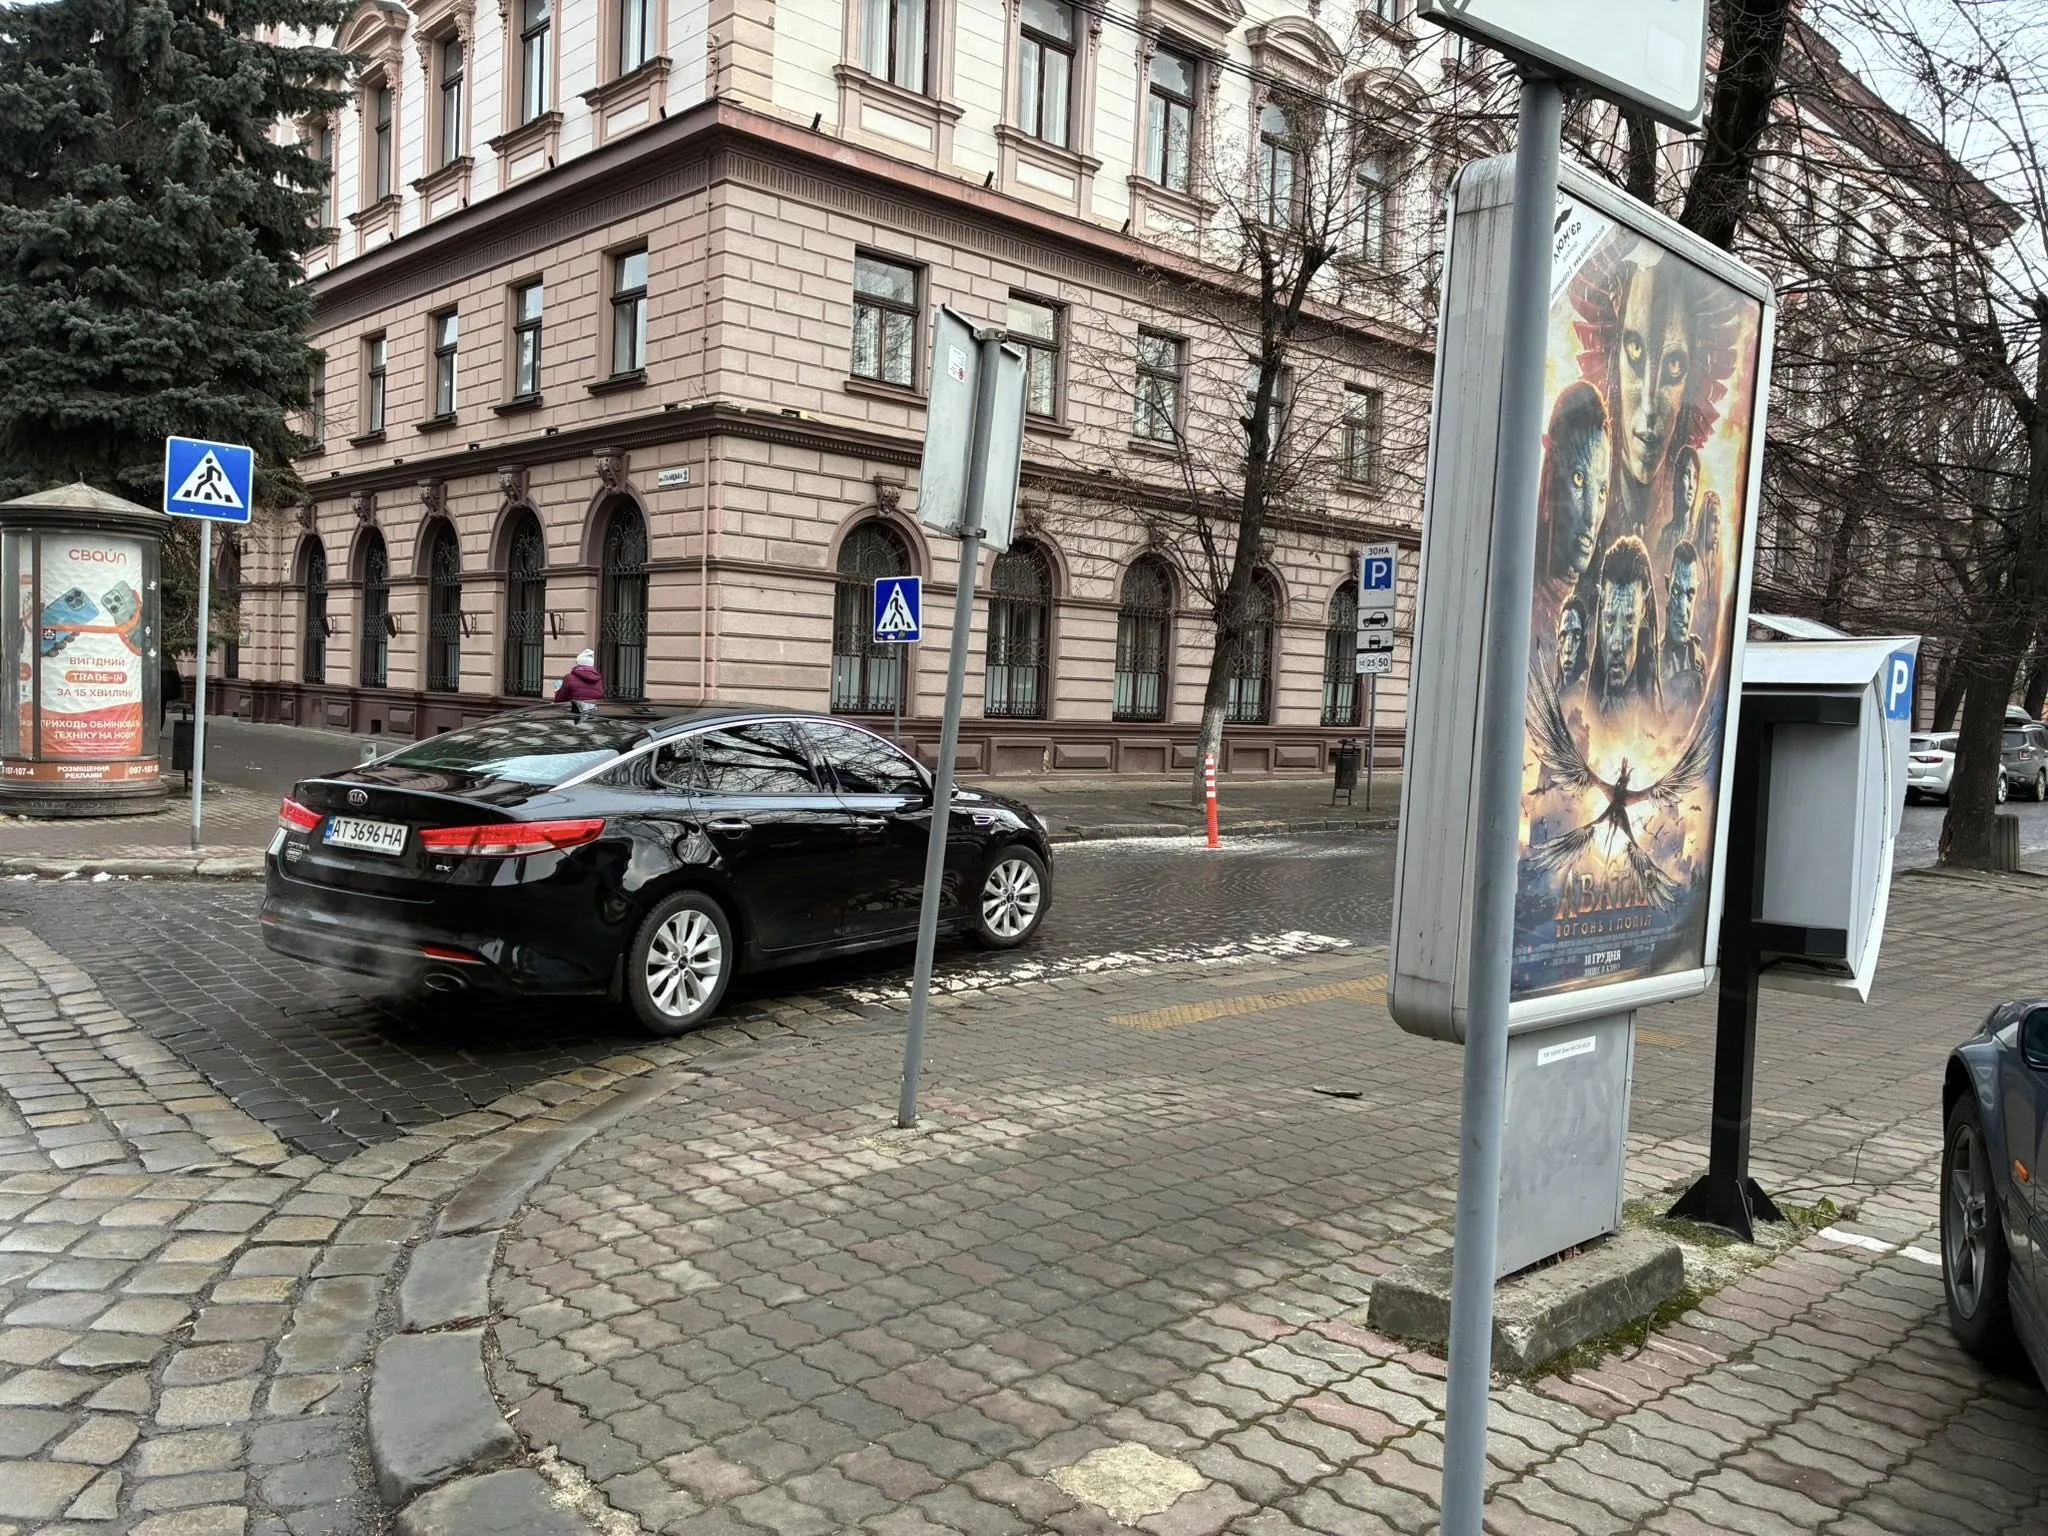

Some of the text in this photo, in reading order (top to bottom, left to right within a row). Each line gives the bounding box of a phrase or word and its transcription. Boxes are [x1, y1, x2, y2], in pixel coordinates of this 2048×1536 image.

[1368, 547, 1390, 556] ЗОНА
[1371, 561, 1388, 587] P
[70, 657, 125, 668] ВИГІДНИЙ
[1367, 659, 1376, 667] 25
[1378, 658, 1389, 667] 50
[72, 672, 123, 682] TRADE-IN
[1890, 660, 1909, 711] P
[57, 688, 71, 696] ЗА
[75, 688, 86, 697] 15
[55, 731, 96, 740] ТЕХНІКУ
[99, 731, 113, 739] НА
[57, 765, 110, 773] РОЗМІЩЕННЯ
[353, 822, 381, 842] 3696
[435, 864, 452, 872] EX
[1556, 922, 1604, 938] ВОГОНЬ
[1616, 915, 1653, 931] ПОПІЛ
[1592, 949, 1621, 965] ГРУДНЯ
